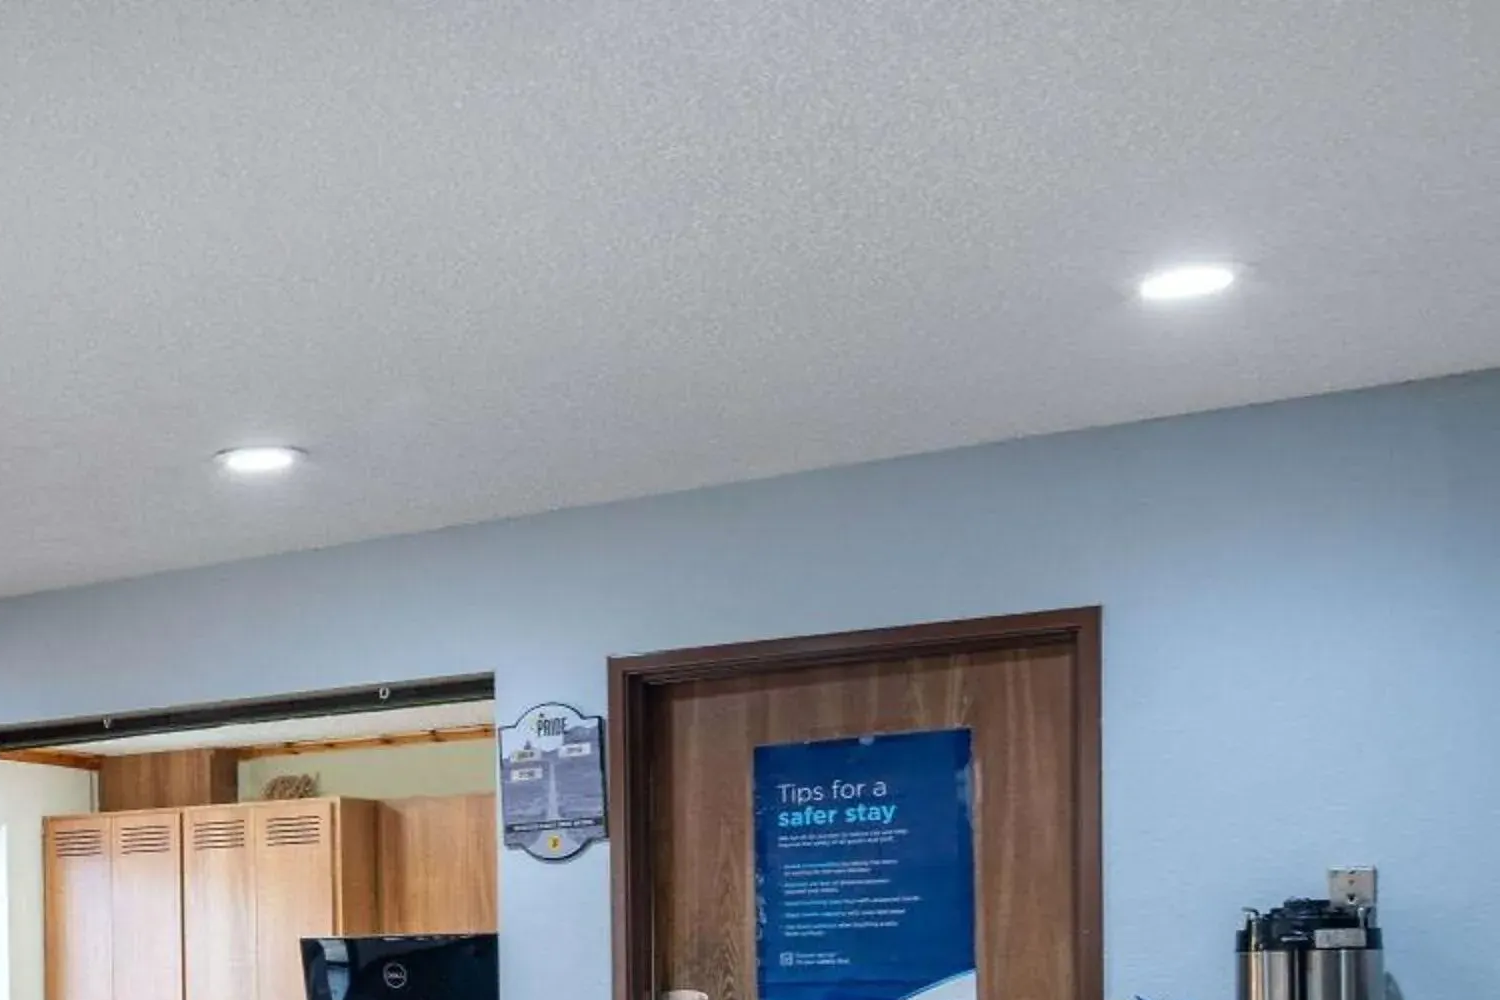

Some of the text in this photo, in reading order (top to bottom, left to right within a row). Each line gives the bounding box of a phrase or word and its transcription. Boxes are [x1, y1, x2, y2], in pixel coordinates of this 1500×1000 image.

[777, 779, 888, 806] Tips for a
[778, 803, 898, 827] safer stay
